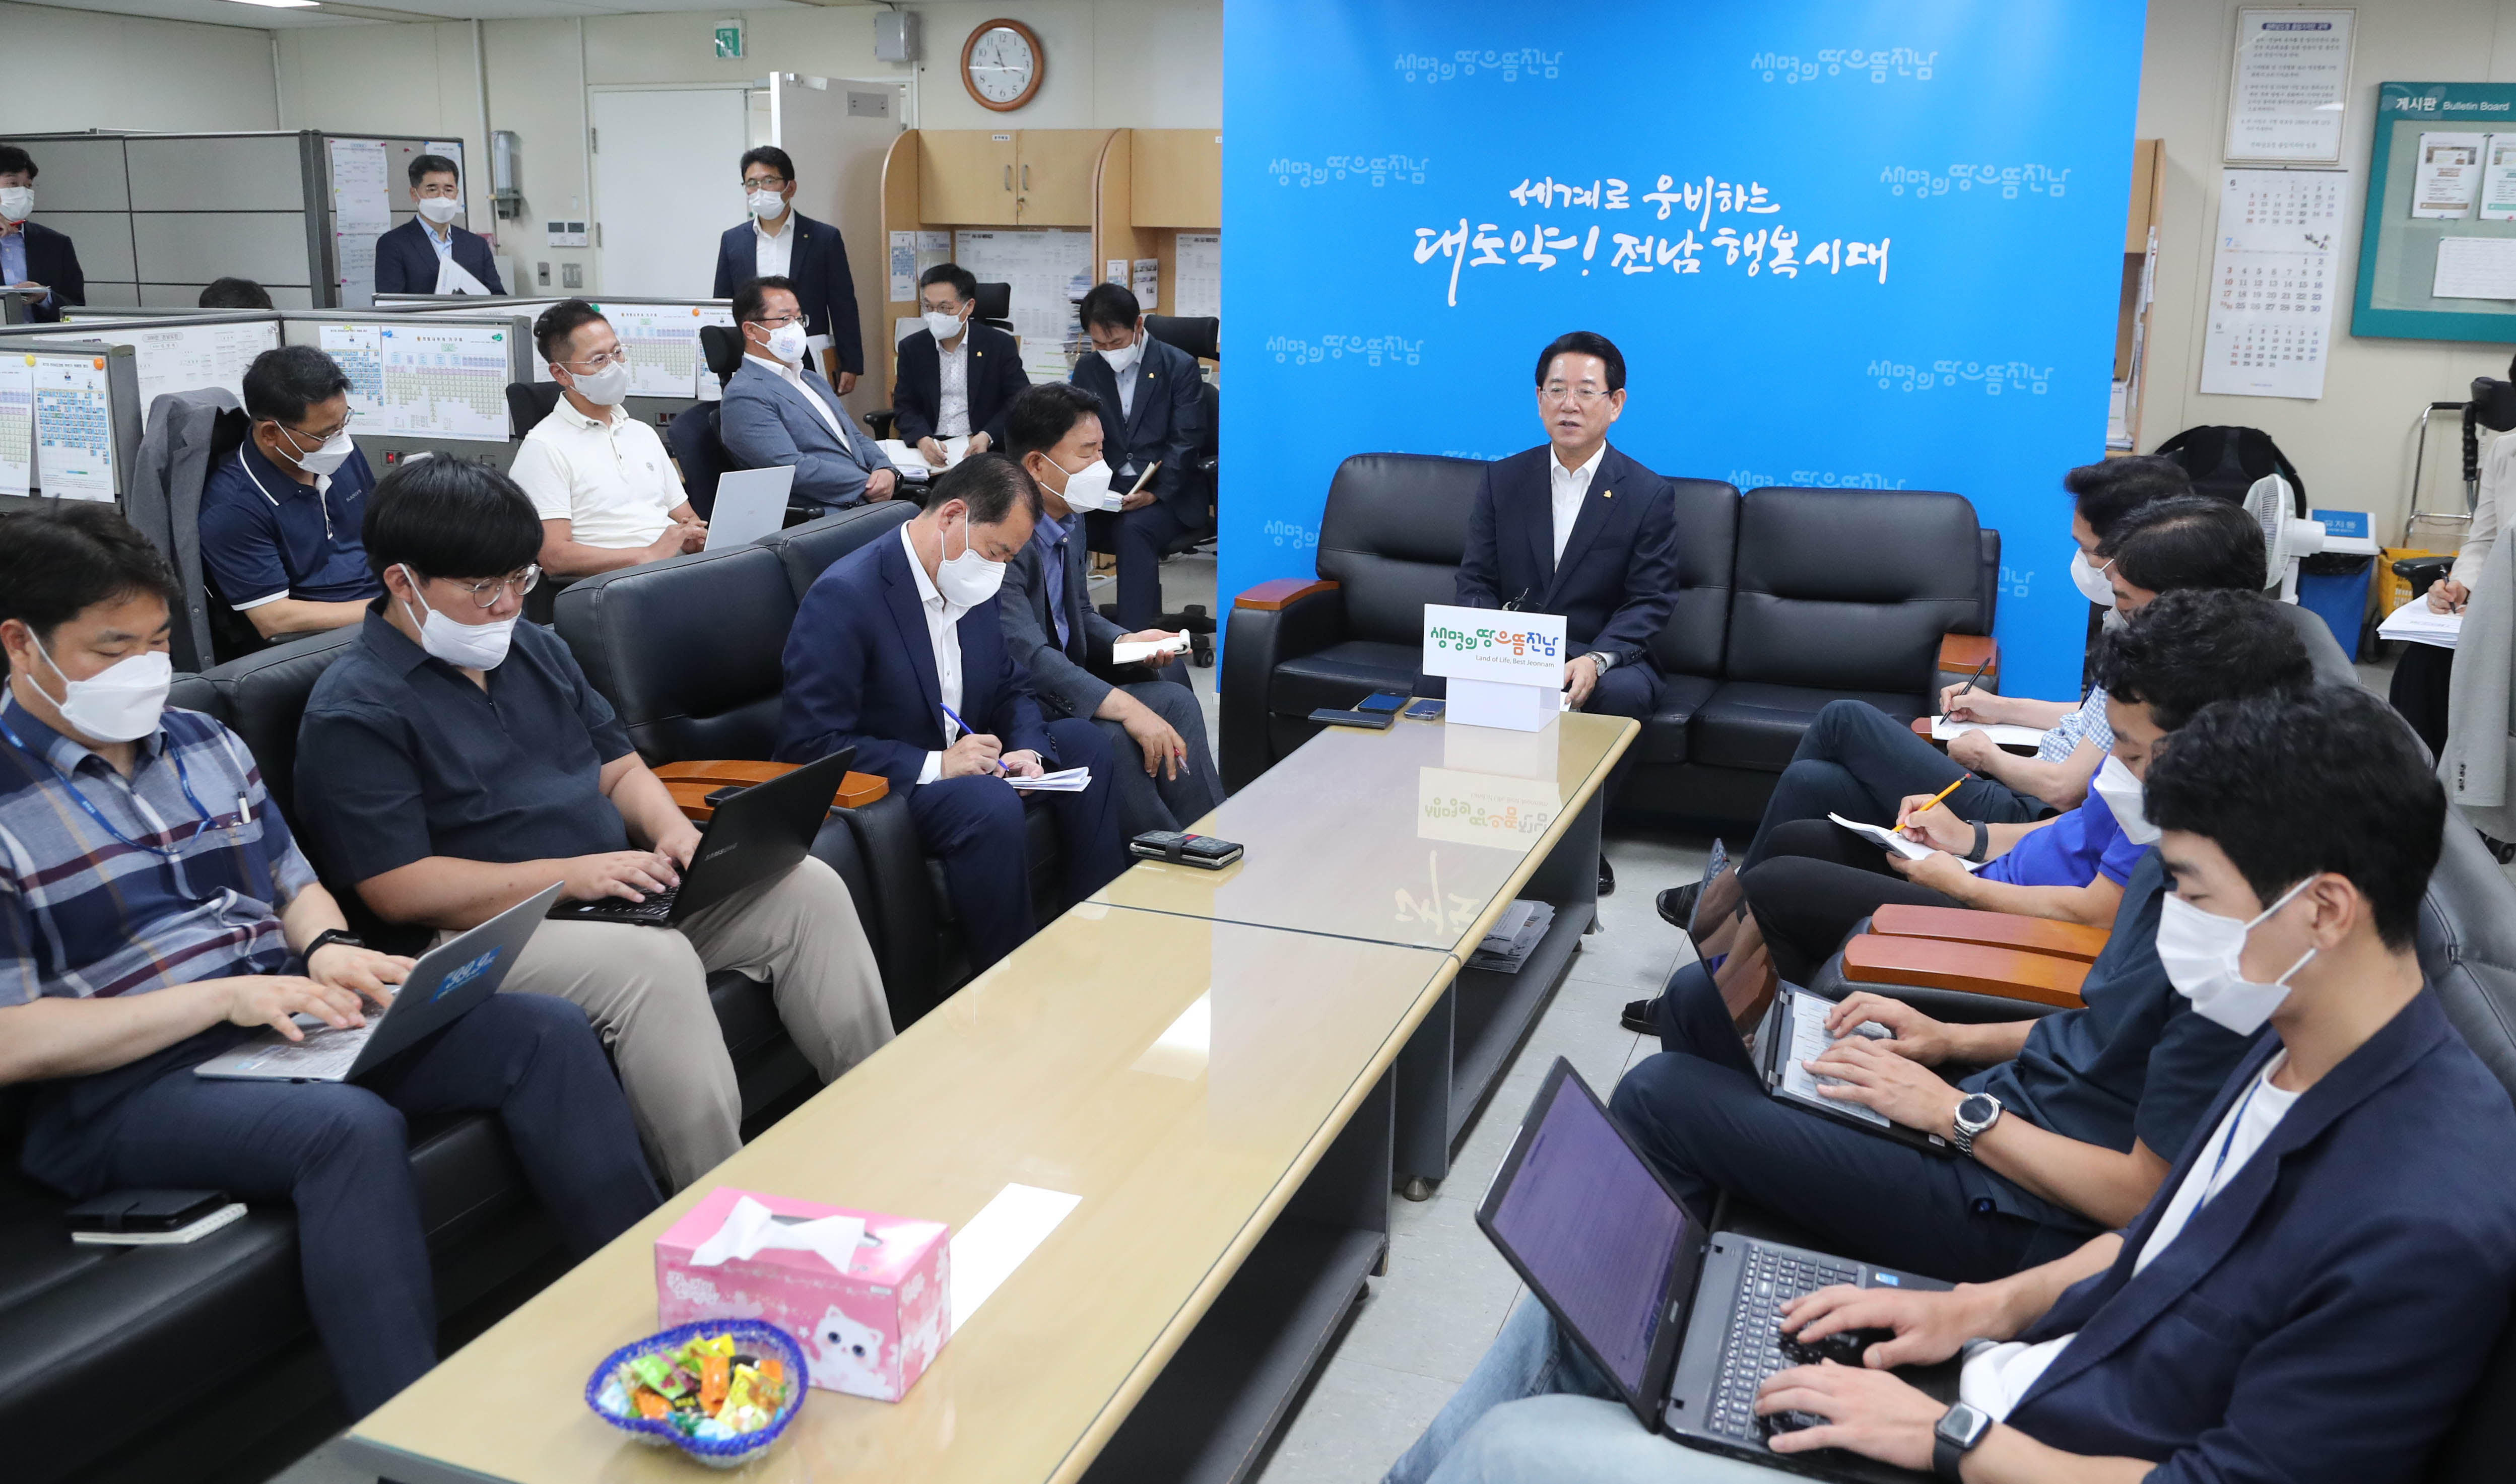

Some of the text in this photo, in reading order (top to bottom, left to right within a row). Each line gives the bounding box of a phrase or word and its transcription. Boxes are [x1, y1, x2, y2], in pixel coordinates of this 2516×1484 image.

[987, 37, 993, 46] 11
[999, 34, 1007, 42] 12
[1022, 48, 1026, 56] 2
[979, 76, 985, 84] 8
[988, 85, 993, 94] 7
[1000, 89, 1006, 97] 6
[1012, 85, 1017, 94] 5
[2396, 97, 2510, 111] 게시판 Bulletin Board
[1510, 175, 1781, 232] 세계로 웅비하는
[2225, 237, 2233, 247] 7
[1414, 219, 1600, 307] 대도약!
[1611, 229, 1704, 275] 전남
[1527, 659, 1555, 668] Jeonnam
